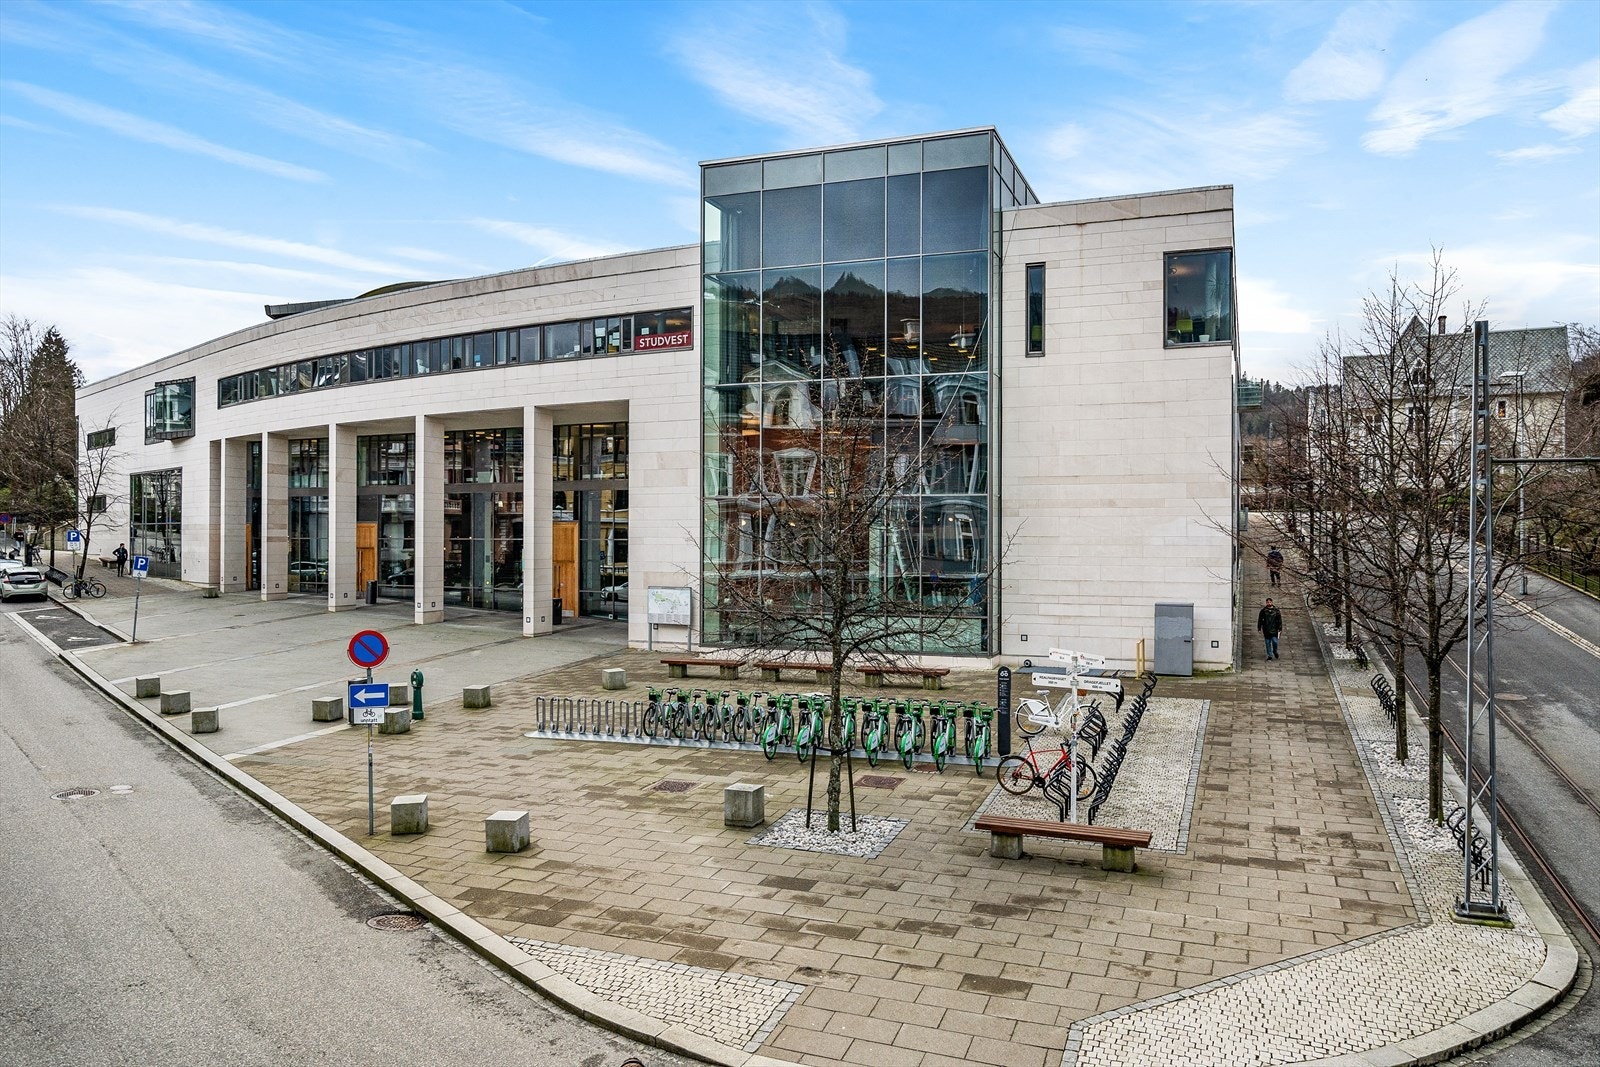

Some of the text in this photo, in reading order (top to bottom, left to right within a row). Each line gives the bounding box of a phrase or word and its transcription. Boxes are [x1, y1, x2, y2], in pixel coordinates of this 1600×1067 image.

[639, 334, 689, 348] STUDVEST
[70, 532, 77, 540] P
[137, 559, 145, 568] P
